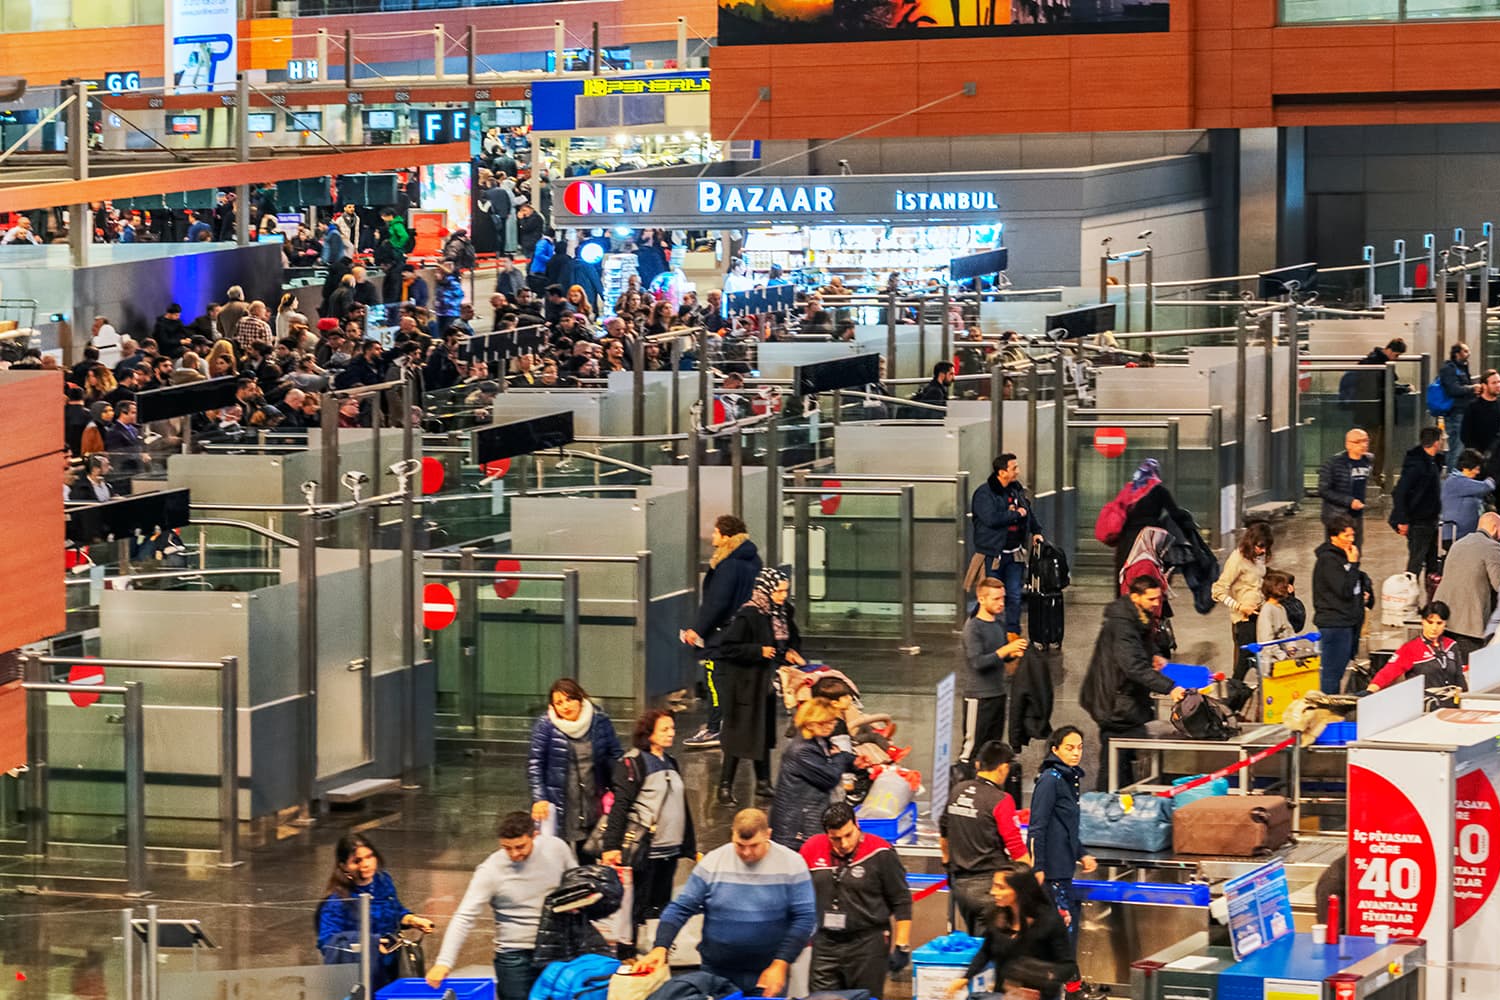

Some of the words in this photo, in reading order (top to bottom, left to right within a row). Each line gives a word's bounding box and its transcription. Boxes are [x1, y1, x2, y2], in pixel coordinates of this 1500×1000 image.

[107, 73, 122, 92] G
[125, 73, 139, 90] G
[425, 113, 442, 141] F
[453, 112, 467, 139] F
[1369, 830, 1423, 844] PİYASAYA
[1369, 842, 1401, 855] GÖRE
[1354, 857, 1421, 900] %40
[1357, 900, 1418, 912] AVANTAJLI
[1362, 910, 1414, 924] FİYATLAR
